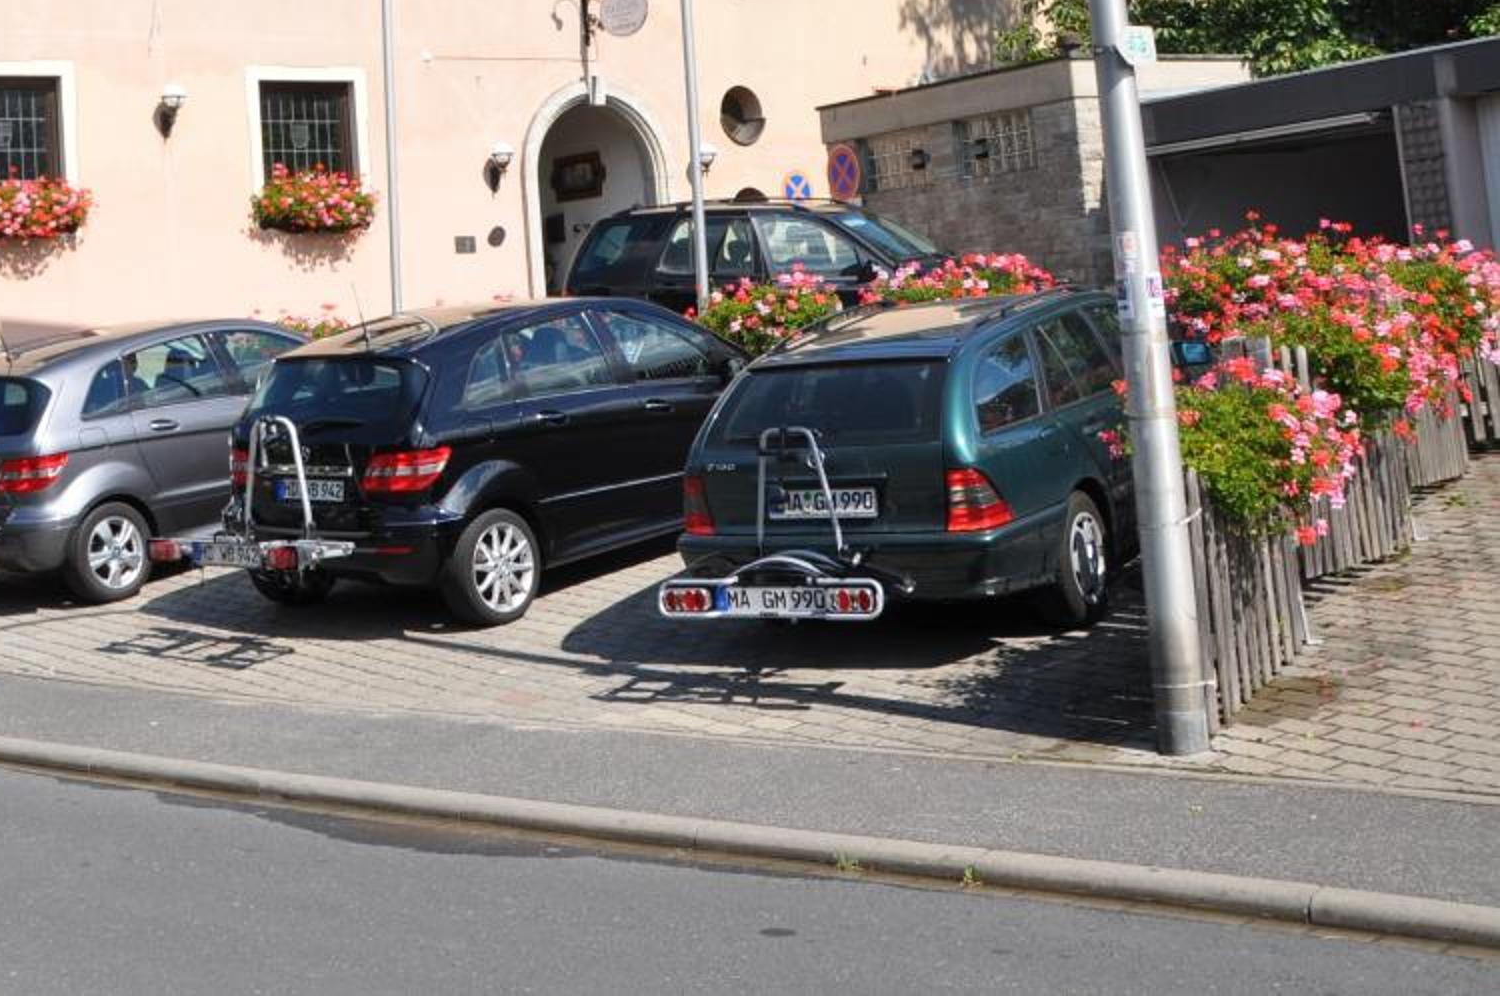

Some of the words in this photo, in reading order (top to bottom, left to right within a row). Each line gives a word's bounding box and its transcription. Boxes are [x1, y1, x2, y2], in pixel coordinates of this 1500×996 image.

[321, 483, 342, 498] 942
[841, 491, 874, 510] 990
[728, 589, 750, 607] MA
[762, 589, 787, 608] GM
[791, 589, 826, 608] 990
